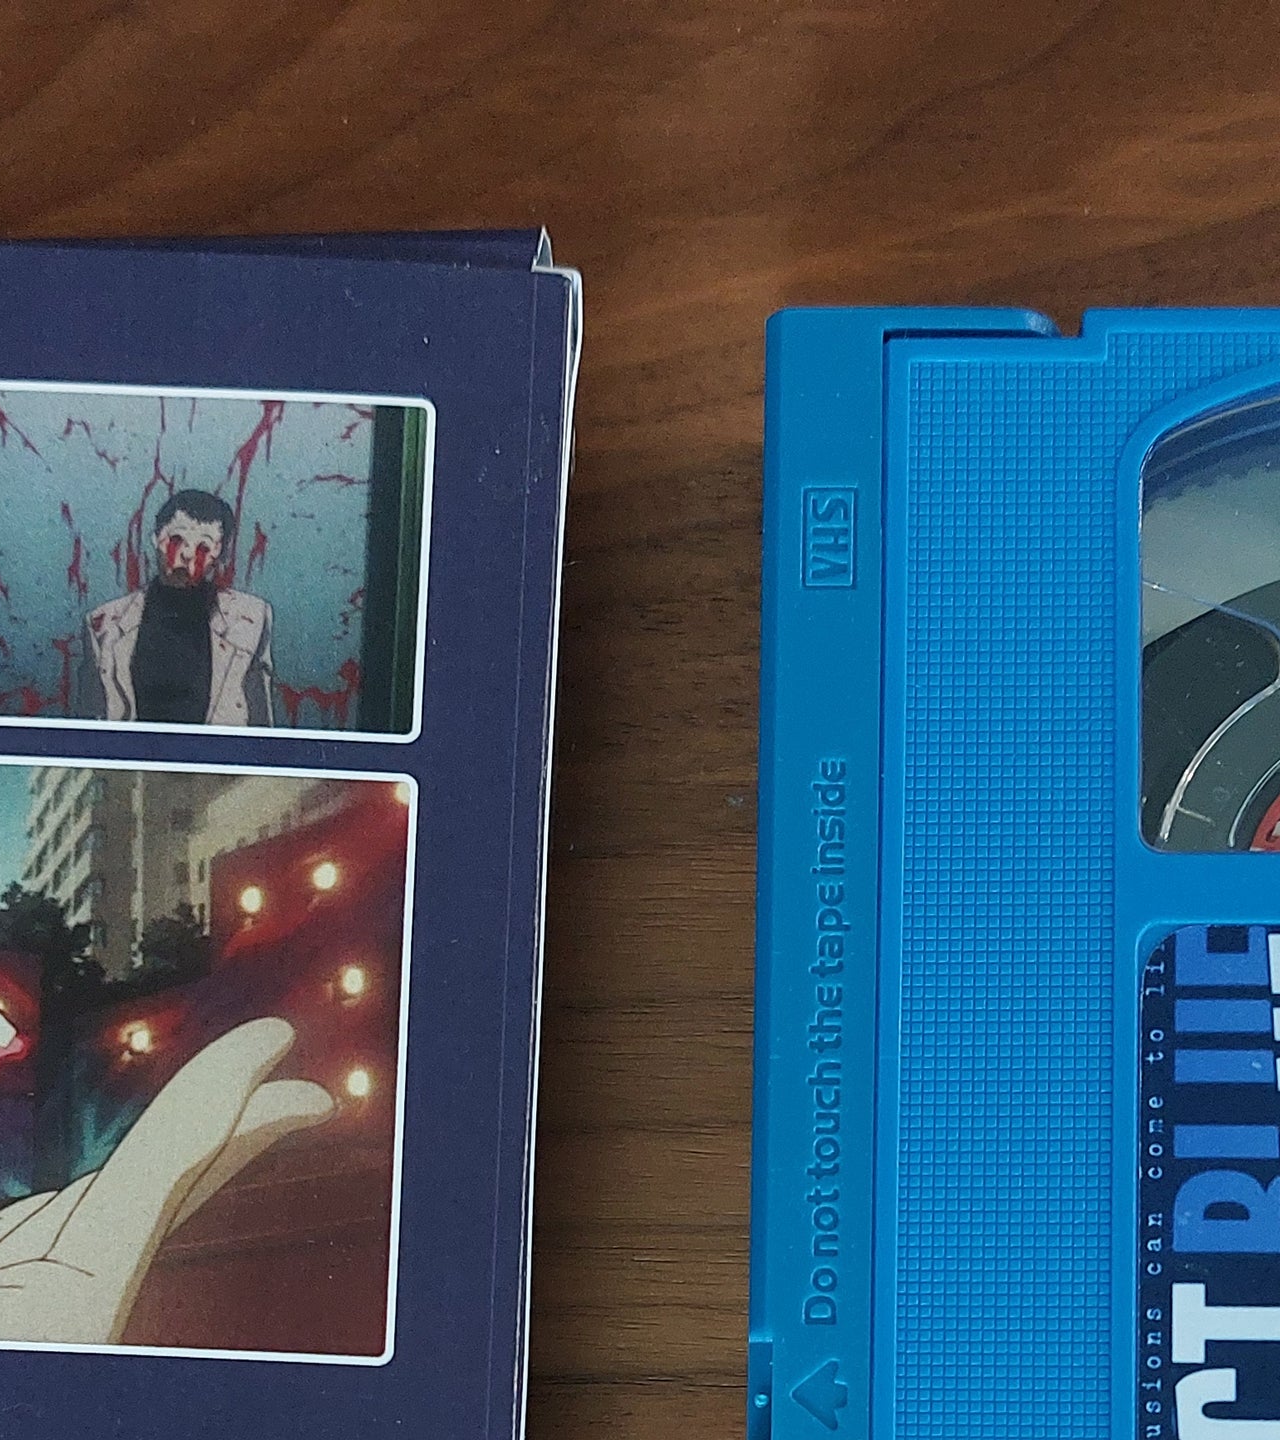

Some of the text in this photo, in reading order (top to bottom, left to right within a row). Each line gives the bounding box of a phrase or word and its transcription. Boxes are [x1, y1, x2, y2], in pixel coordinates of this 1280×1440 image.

[809, 493, 848, 580] VHS
[801, 757, 852, 1326] Do not touch the tape inside
[1143, 1028, 1164, 1063] to
[1145, 1095, 1163, 1178] come
[1145, 1211, 1163, 1273] can
